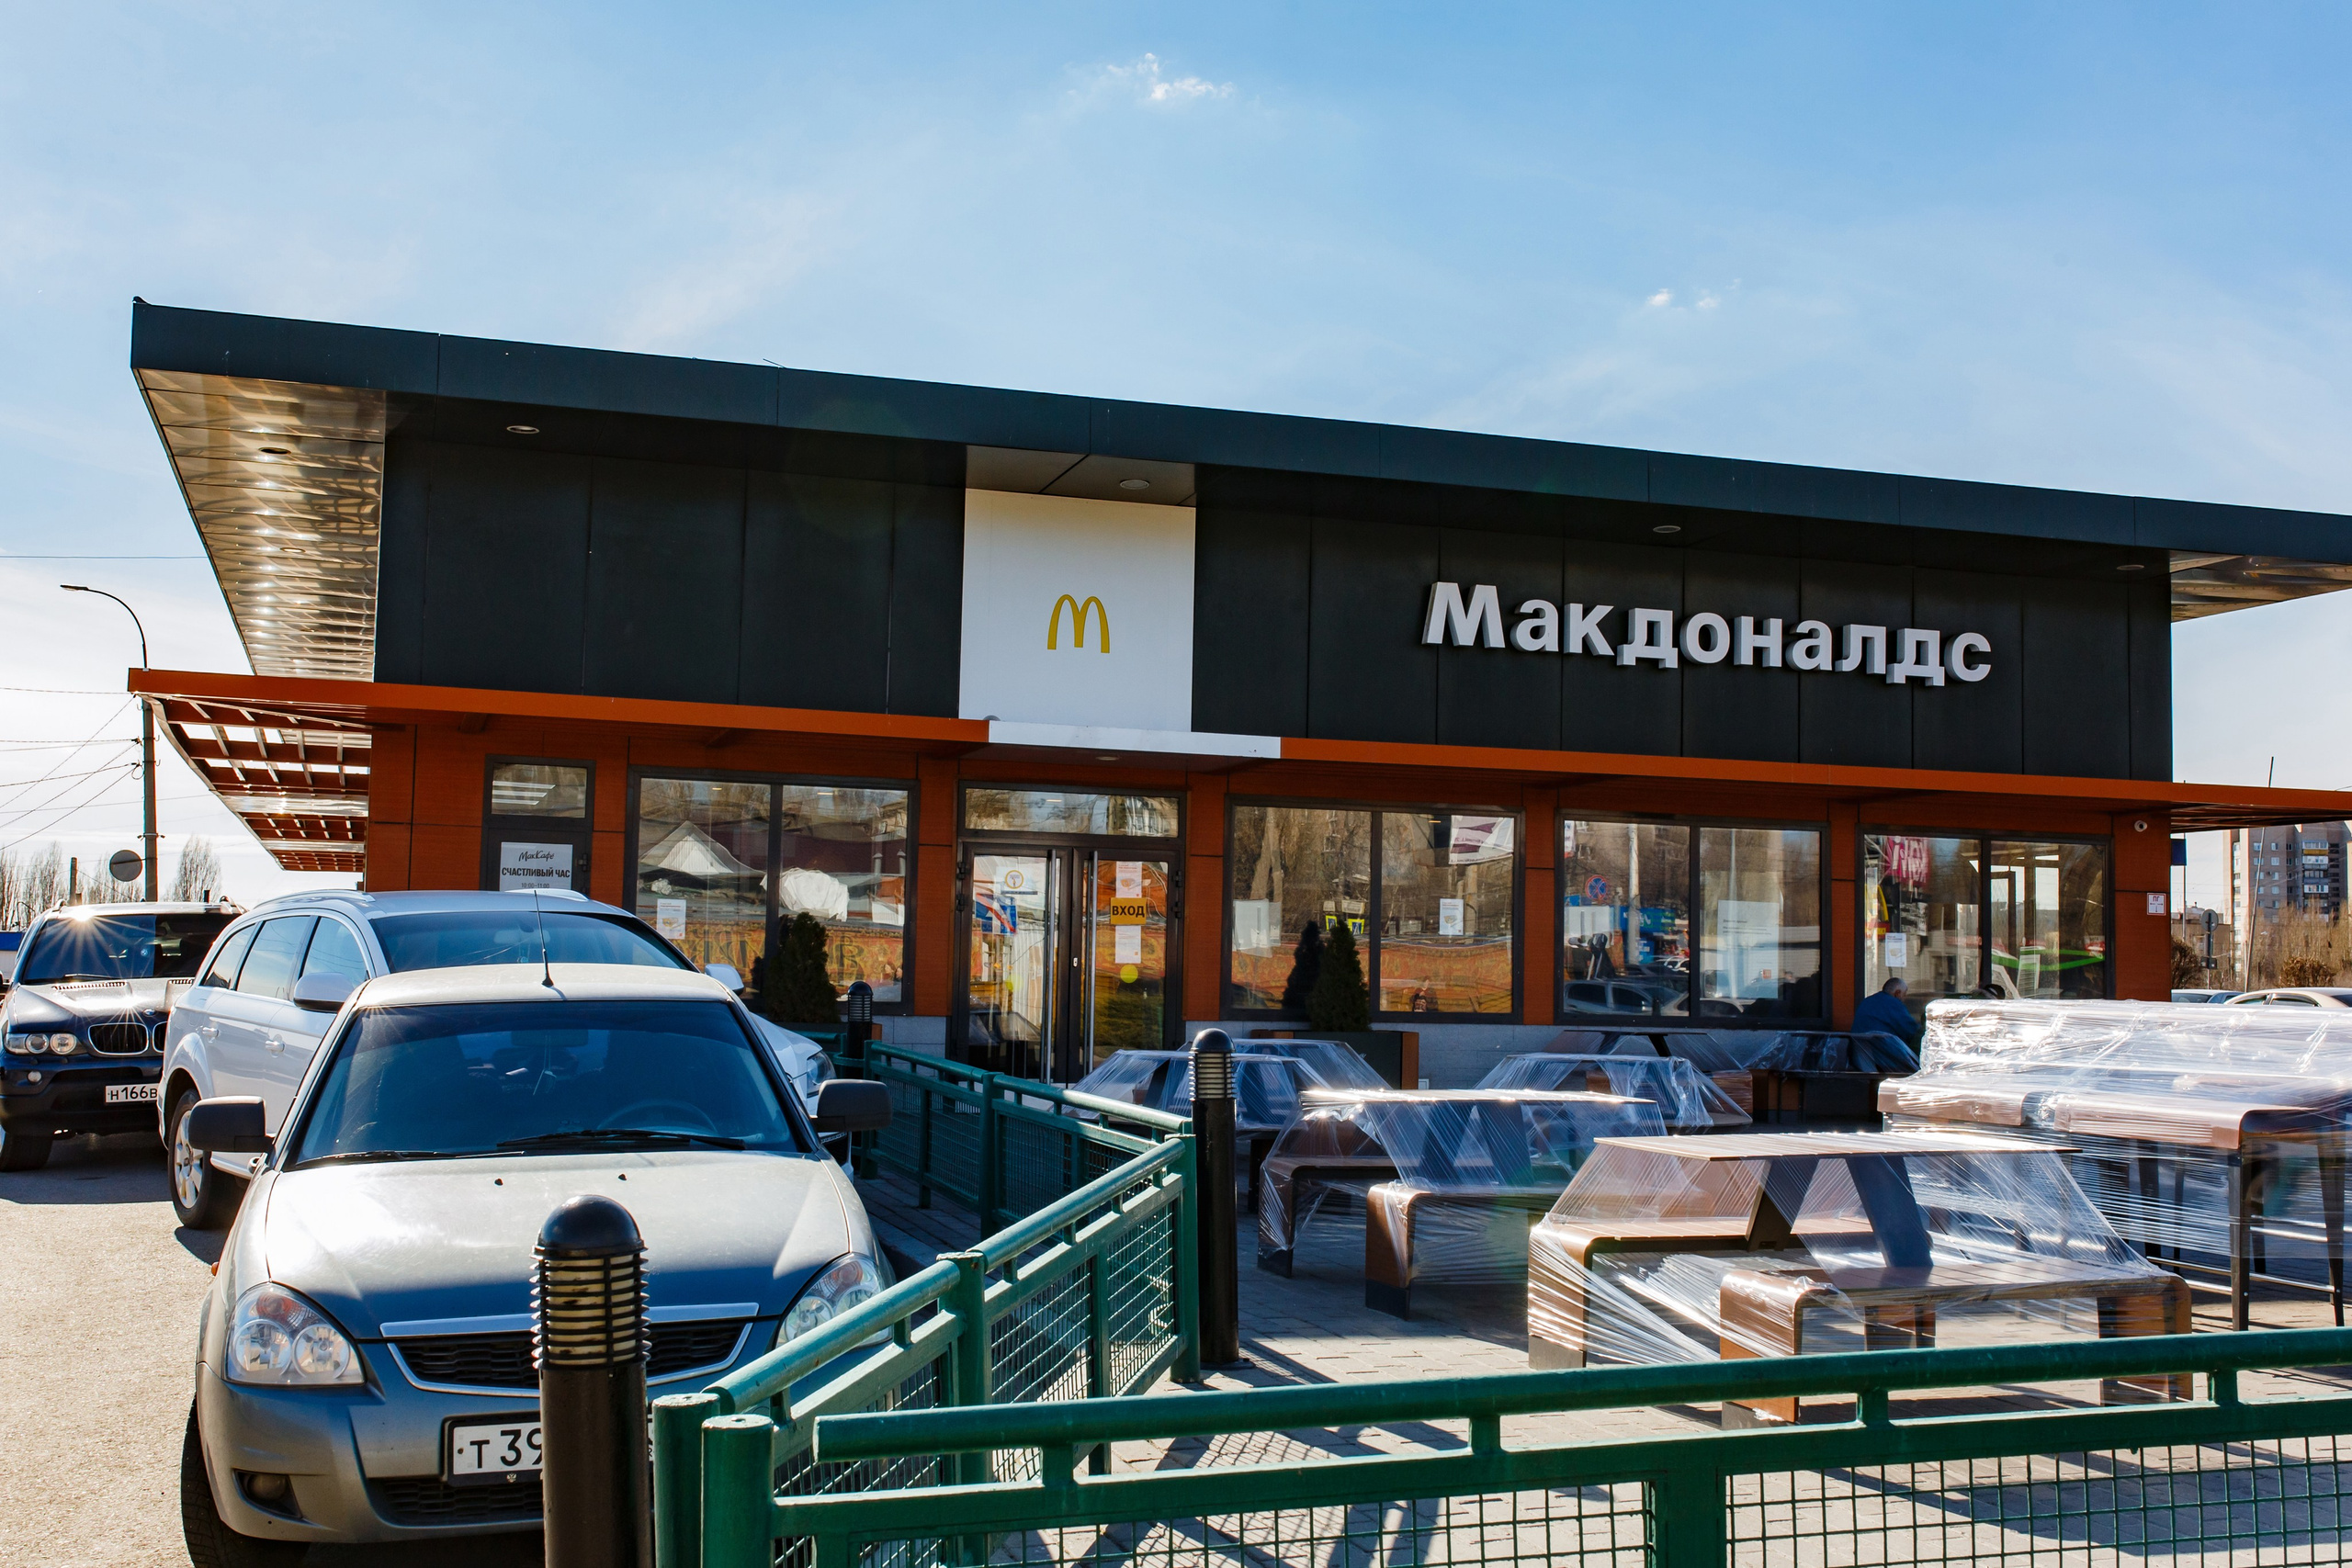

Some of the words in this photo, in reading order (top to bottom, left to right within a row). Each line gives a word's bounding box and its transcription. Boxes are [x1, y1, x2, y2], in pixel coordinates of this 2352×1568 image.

[1421, 581, 1992, 687] Макдоналдс
[502, 867, 553, 877] СЧАСТЛИВЫЙ
[555, 869, 571, 878] ЧАС
[1112, 906, 1145, 918] ВХОД
